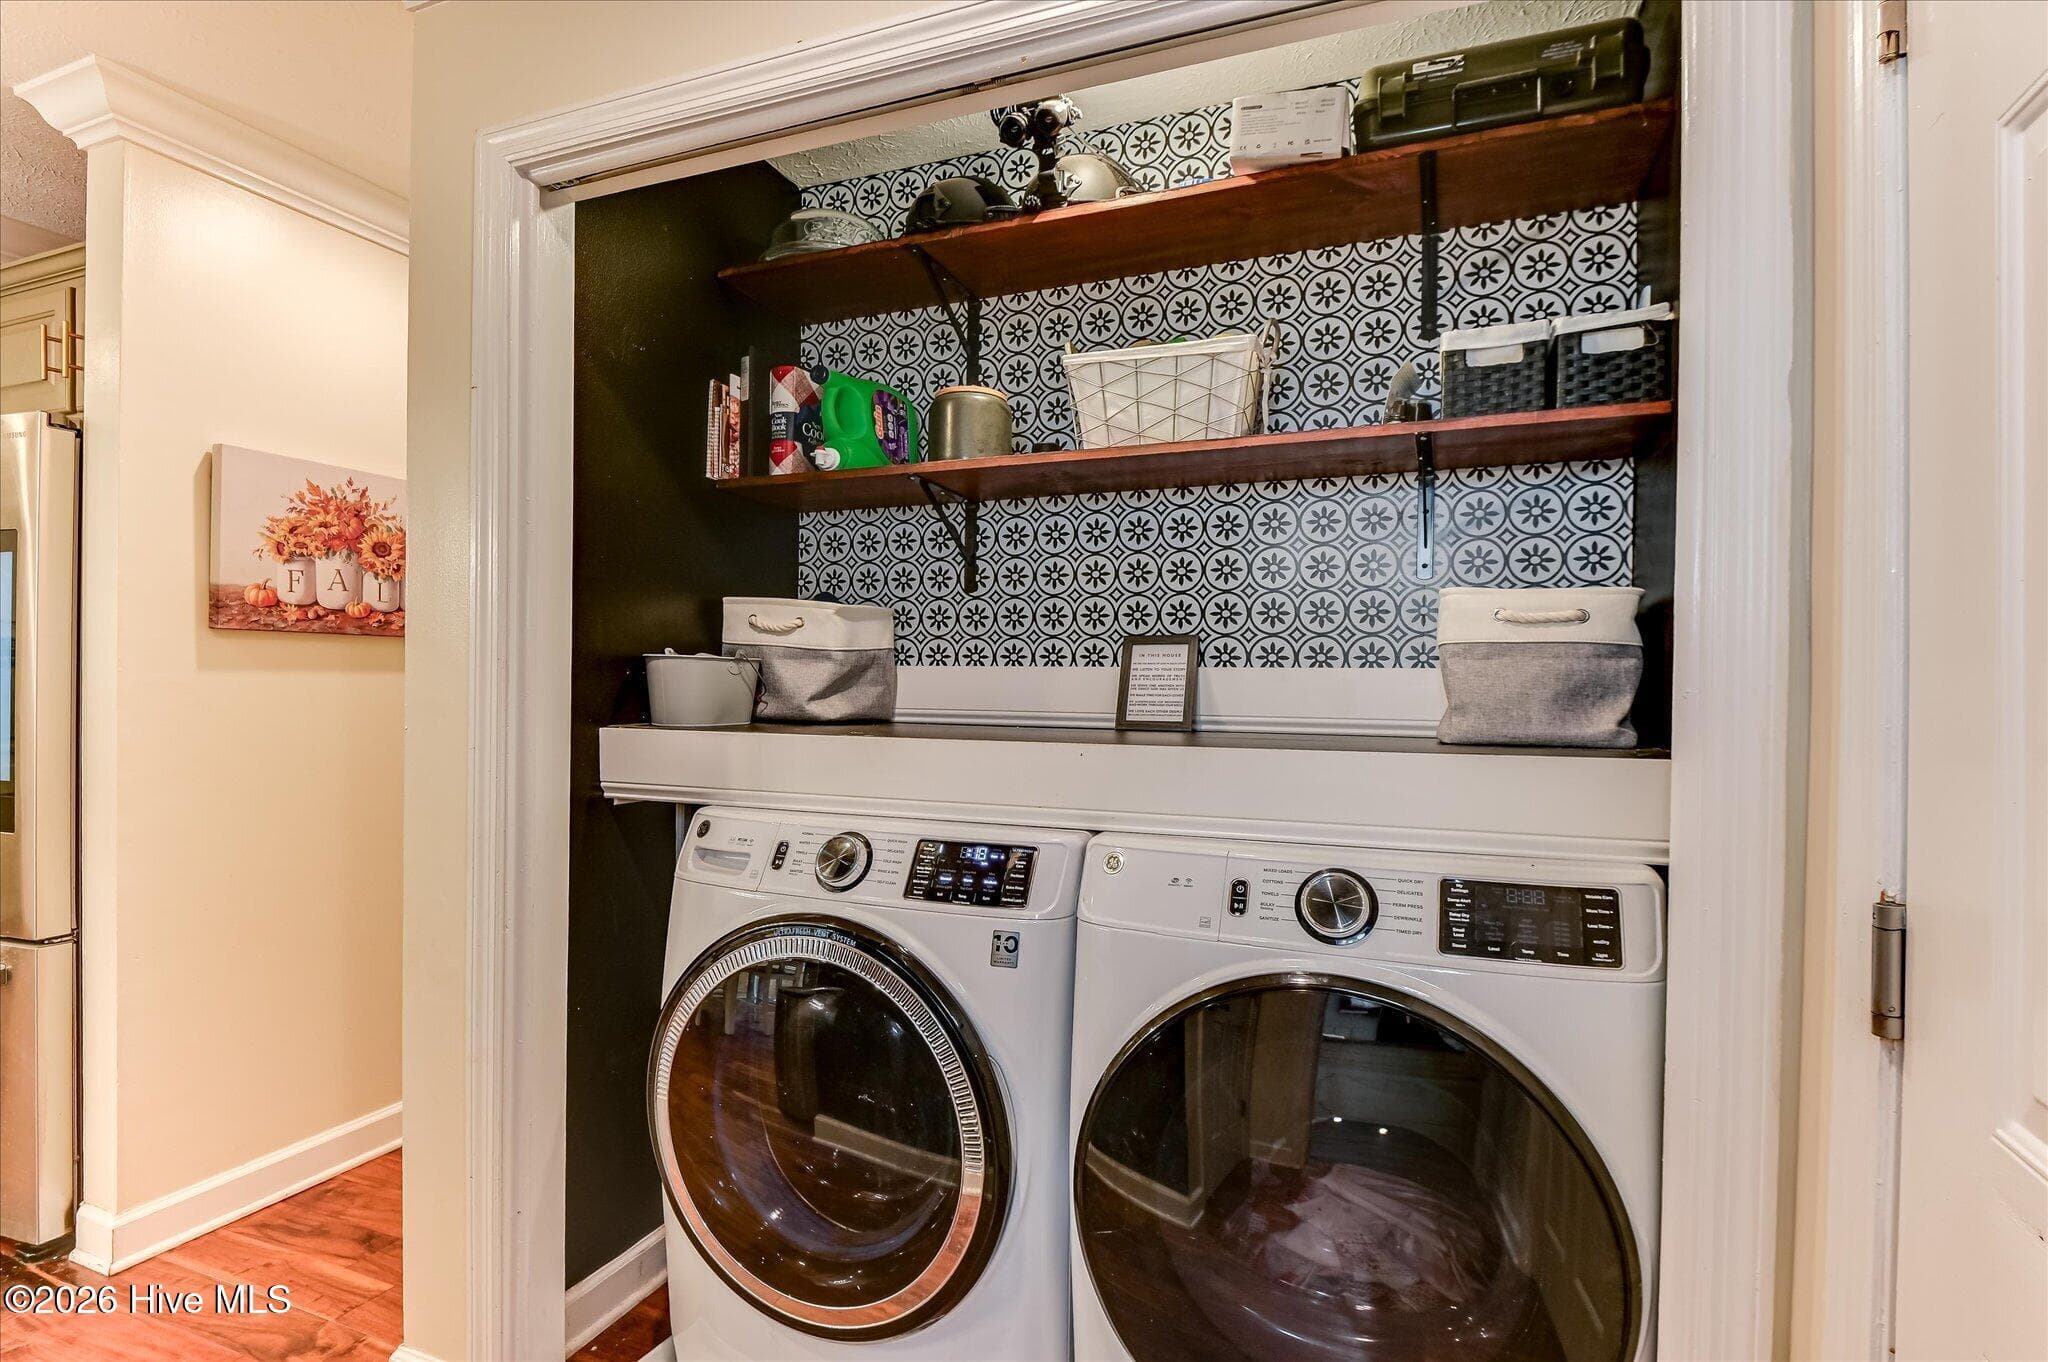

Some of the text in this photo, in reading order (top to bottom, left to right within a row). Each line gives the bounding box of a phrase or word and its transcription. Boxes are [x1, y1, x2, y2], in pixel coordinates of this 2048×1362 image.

[771, 417, 787, 425] Cook
[802, 422, 825, 441] Coo
[814, 928, 830, 938] VENT
[832, 932, 857, 947] SYSTEM
[993, 934, 1019, 954] 10
